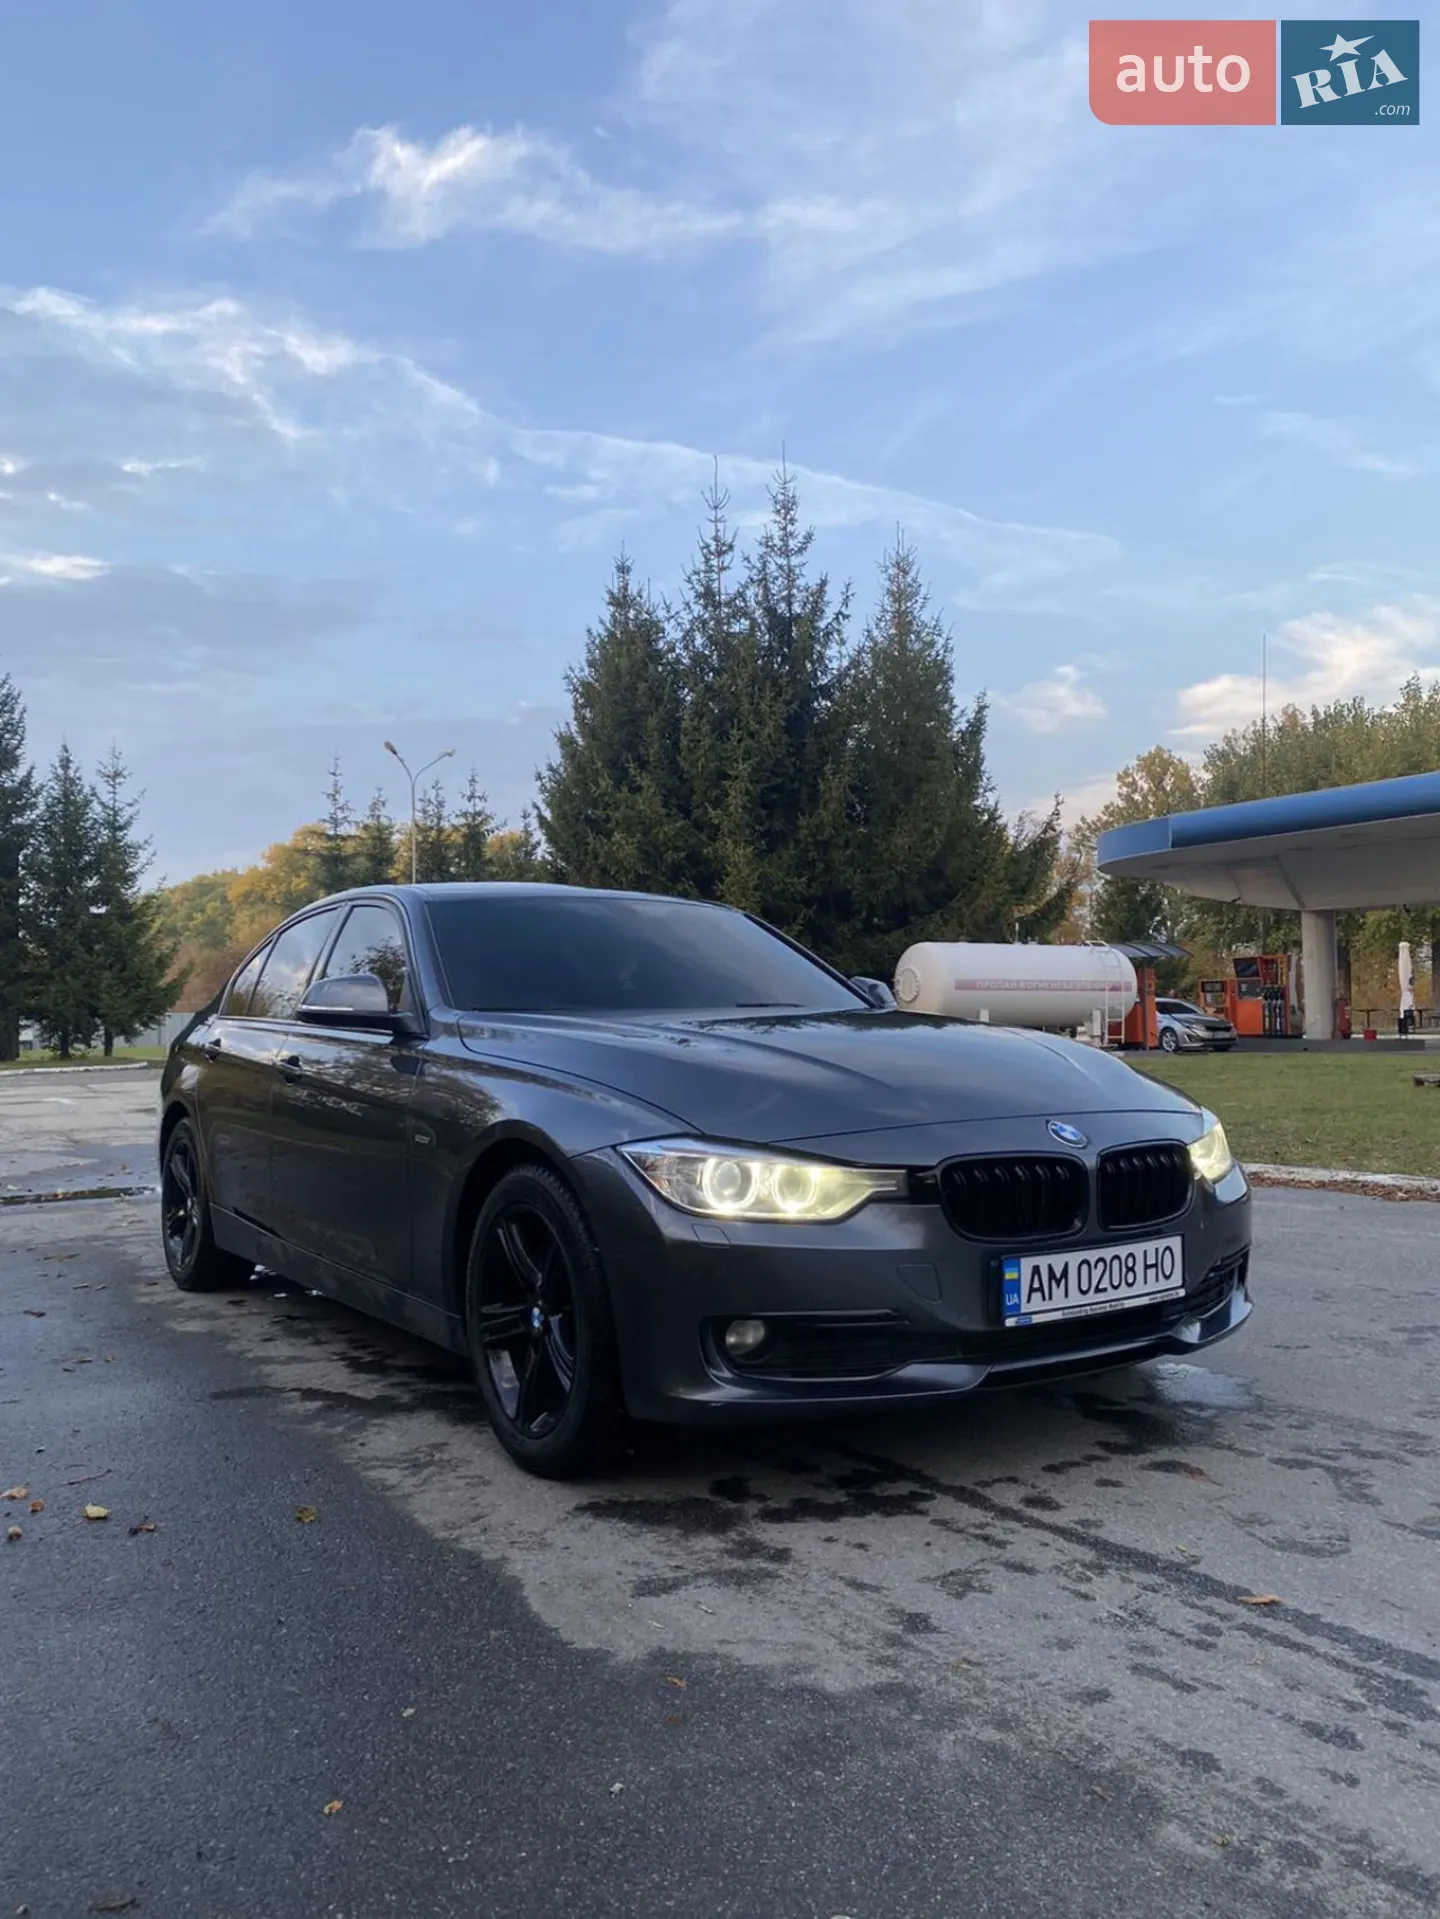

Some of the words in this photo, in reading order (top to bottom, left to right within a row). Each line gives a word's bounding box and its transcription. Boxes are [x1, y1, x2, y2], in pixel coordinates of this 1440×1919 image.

[1026, 1261, 1069, 1304] AM
[1077, 1252, 1137, 1296] 0208
[1143, 1245, 1175, 1285] HO
[1005, 1293, 1019, 1306] UA
